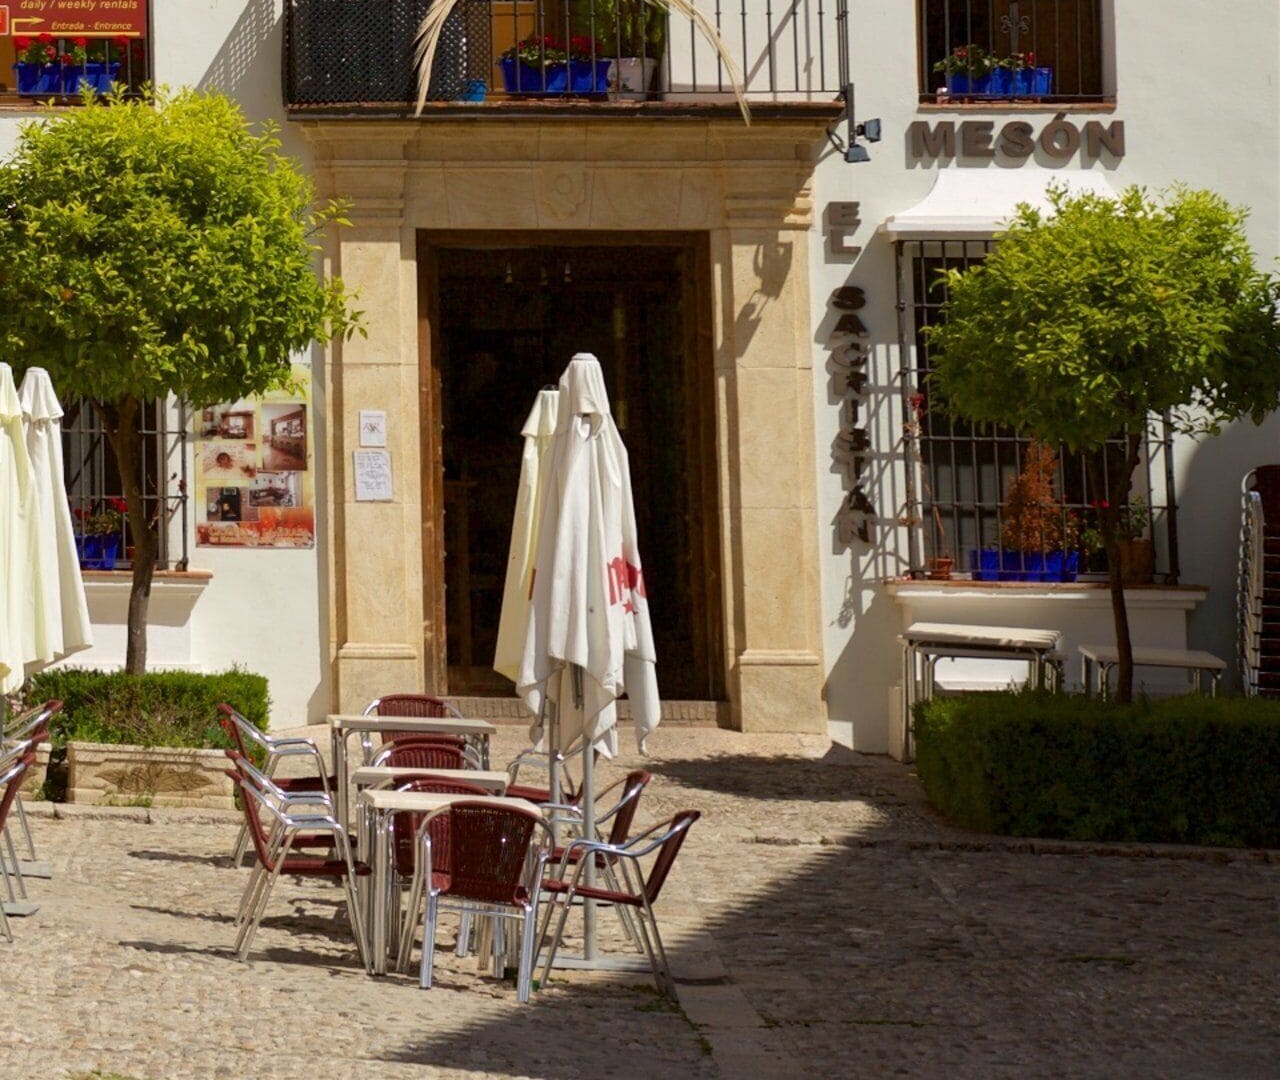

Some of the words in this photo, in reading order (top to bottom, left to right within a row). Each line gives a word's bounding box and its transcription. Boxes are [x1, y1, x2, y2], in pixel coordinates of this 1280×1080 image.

[20, 0, 46, 11] daily
[58, 0, 96, 11] weekly
[100, 0, 138, 9] rentals
[51, 21, 85, 30] Entrada
[94, 21, 132, 30] Entrance
[910, 111, 1125, 157] MESÓN
[827, 201, 861, 254] EL
